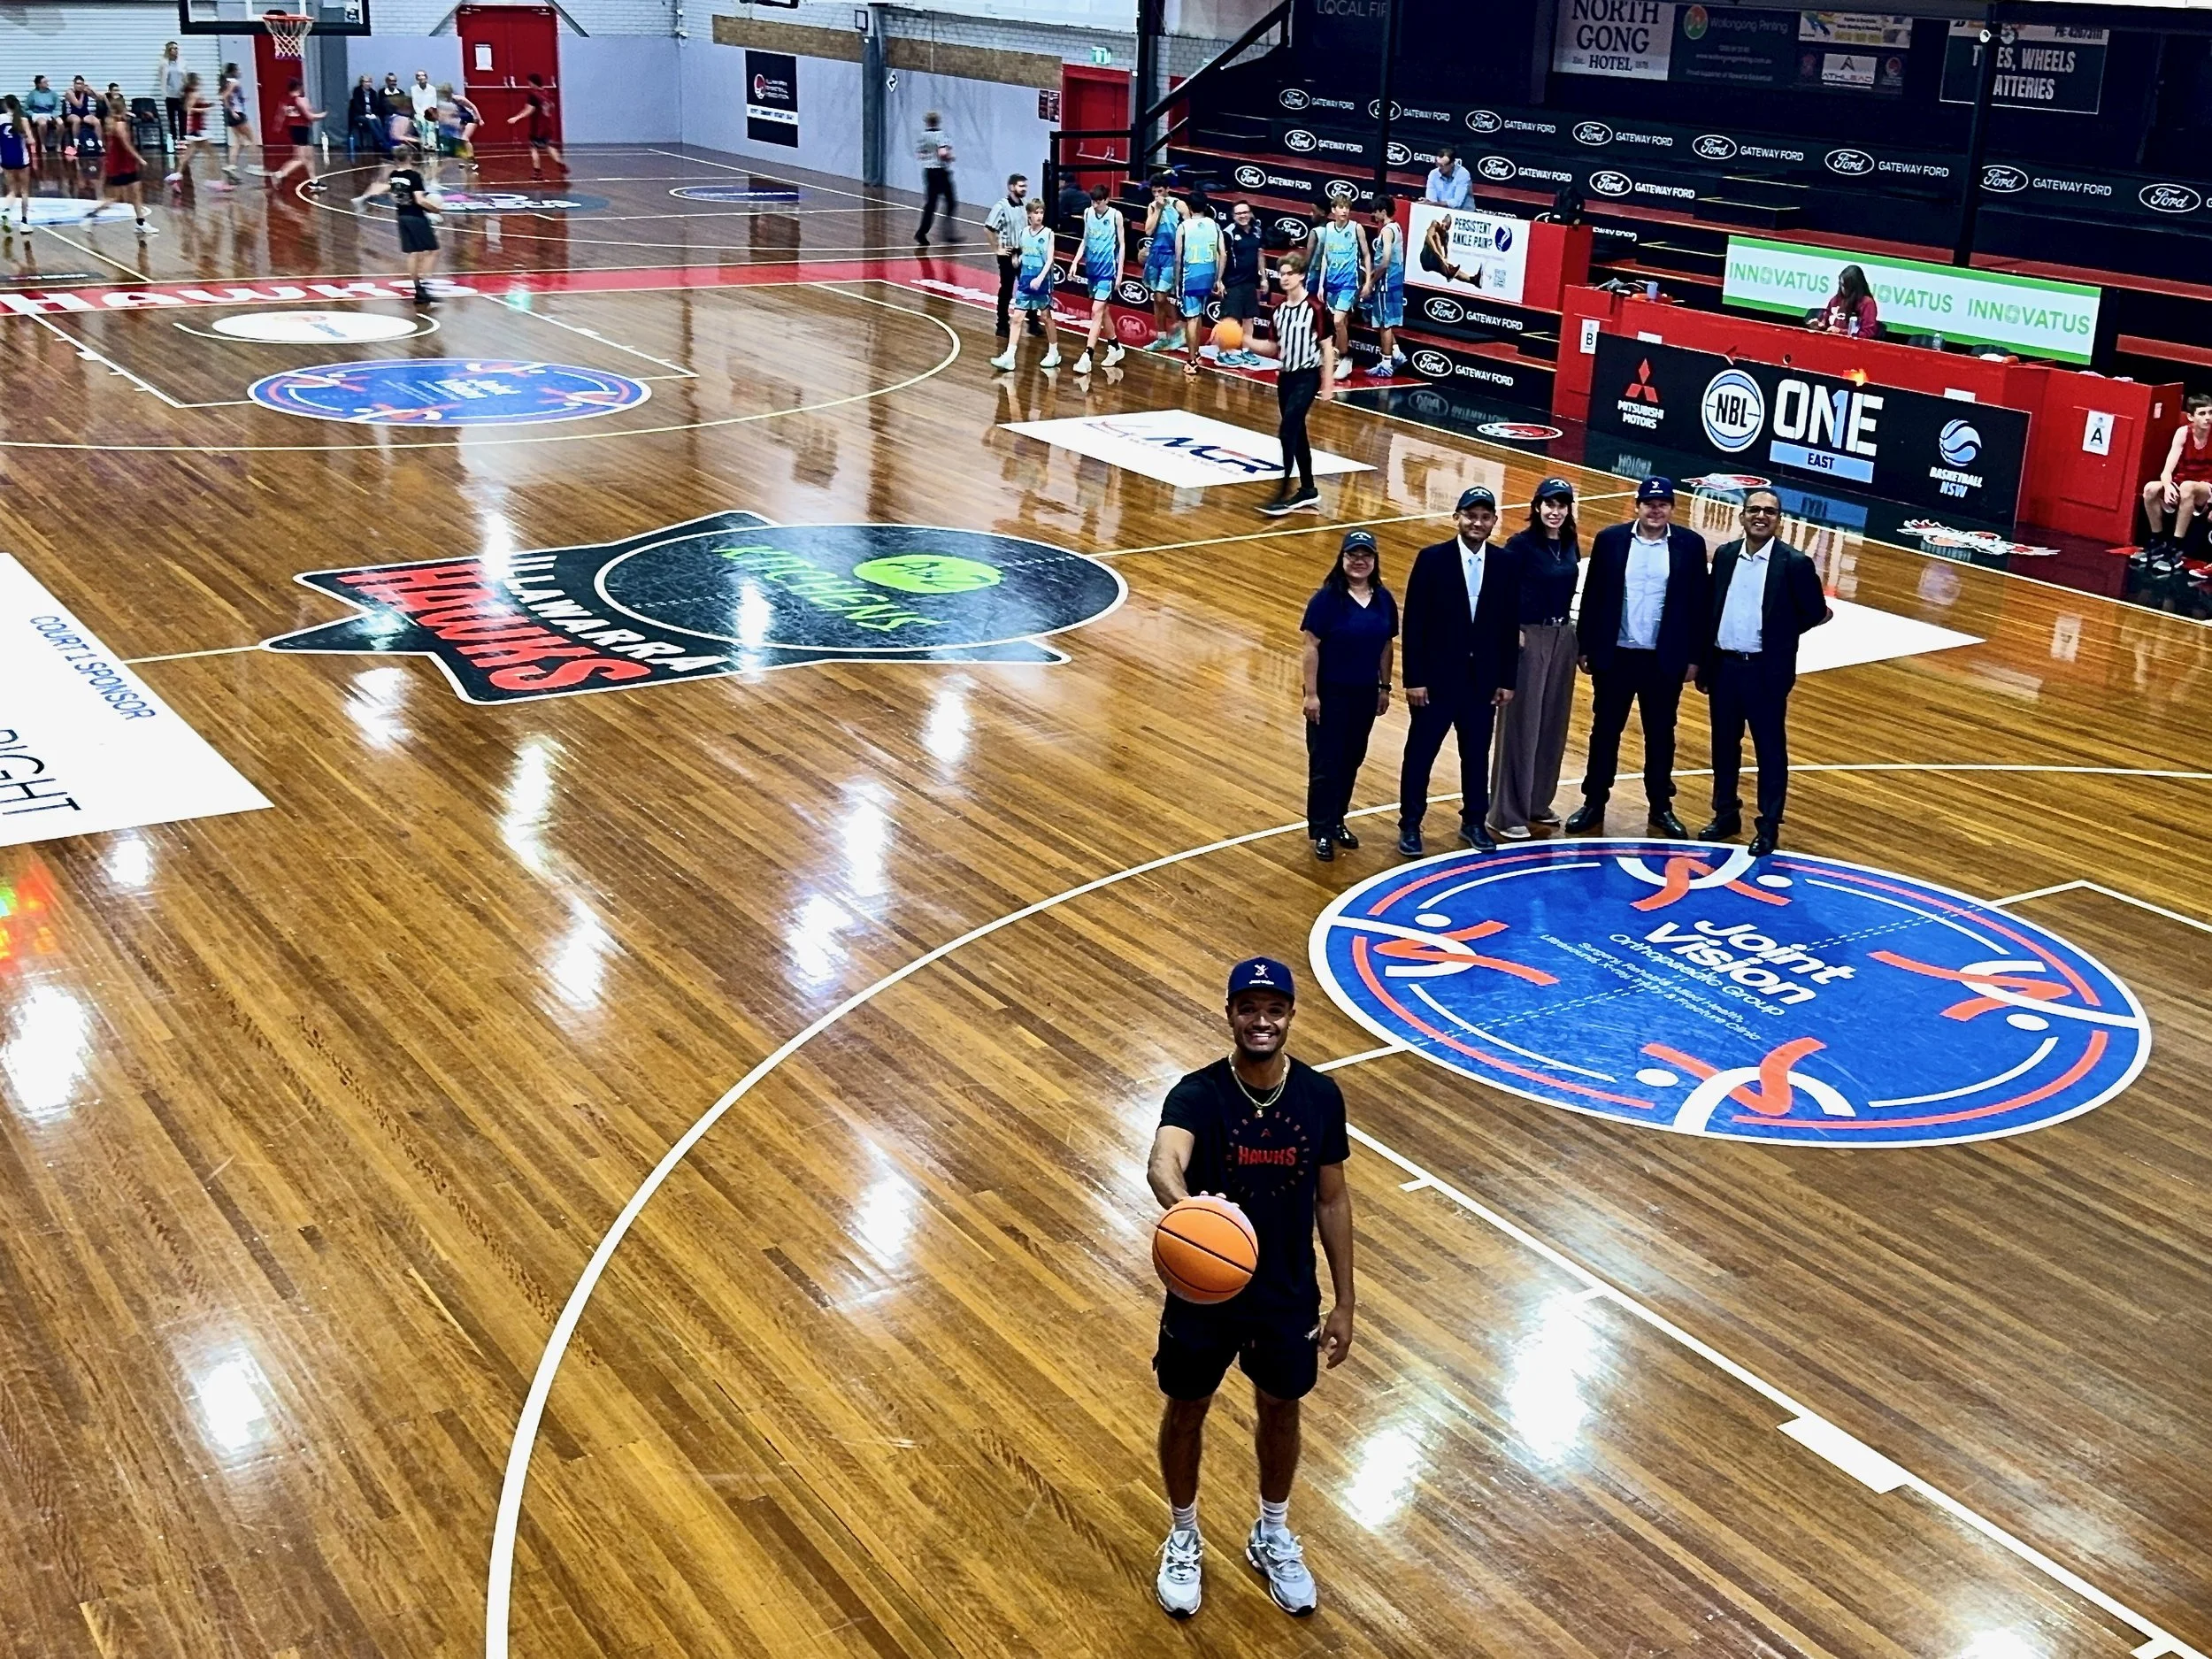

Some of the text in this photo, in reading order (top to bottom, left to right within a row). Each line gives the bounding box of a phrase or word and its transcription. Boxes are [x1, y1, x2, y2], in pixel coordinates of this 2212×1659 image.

[1571, 0, 1659, 25] NORTH
[1577, 24, 1650, 54] GONG
[1588, 54, 1632, 72] HOTEL
[1972, 45, 2077, 73] TES, WHEELS
[1993, 74, 2055, 100] ATTERIES
[1472, 113, 1556, 134] Ford GATEWAY FORD
[1579, 125, 1673, 146] Ford GATEWAY FORD
[1414, 152, 1437, 164] GATEW
[1701, 138, 1804, 161] Ford GATEWAY FORD
[1485, 159, 1573, 182] Ford GATEWAY FORD
[1834, 152, 1949, 178] Ford GATEWAY FORD
[1596, 174, 1696, 199] Ford GATEWAY FORD
[1983, 168, 2112, 196] Ford GATEWAY FORD
[2150, 187, 2189, 209] Ford
[1454, 217, 1493, 235] PERSISTENT
[1452, 232, 1494, 250] ANKLE PAIN?
[1728, 261, 1831, 295] INNOVATUS
[1871, 282, 1953, 313] OVATUS
[1432, 300, 1523, 331] Ford GATEWAY FORD
[1968, 297, 2091, 335] INNOVATUS
[1348, 339, 1376, 352] ATEWAY
[1586, 332, 1594, 346] B
[1419, 353, 1514, 387] Ford GATEWAY FORD
[1617, 400, 1664, 420] MITSUBISHI
[1622, 411, 1657, 430] MOTORS
[1715, 393, 1747, 429] NBL
[2090, 427, 2104, 445] A
[1807, 452, 1835, 471] EAST
[1929, 466, 1983, 488] BASKETBALL
[1939, 480, 1969, 498] NSW
[710, 546, 952, 632] KITCHENS
[504, 555, 733, 672] ILLAWARRA
[335, 563, 652, 690] HAWKS
[29, 615, 90, 652] COURT
[74, 661, 157, 721] SPONSOR
[1644, 921, 1817, 1005] Vision
[1694, 920, 1857, 985] Joint
[1609, 933, 1786, 1016] Orthopaedic Group
[1239, 1145, 1297, 1165] HAWKS
